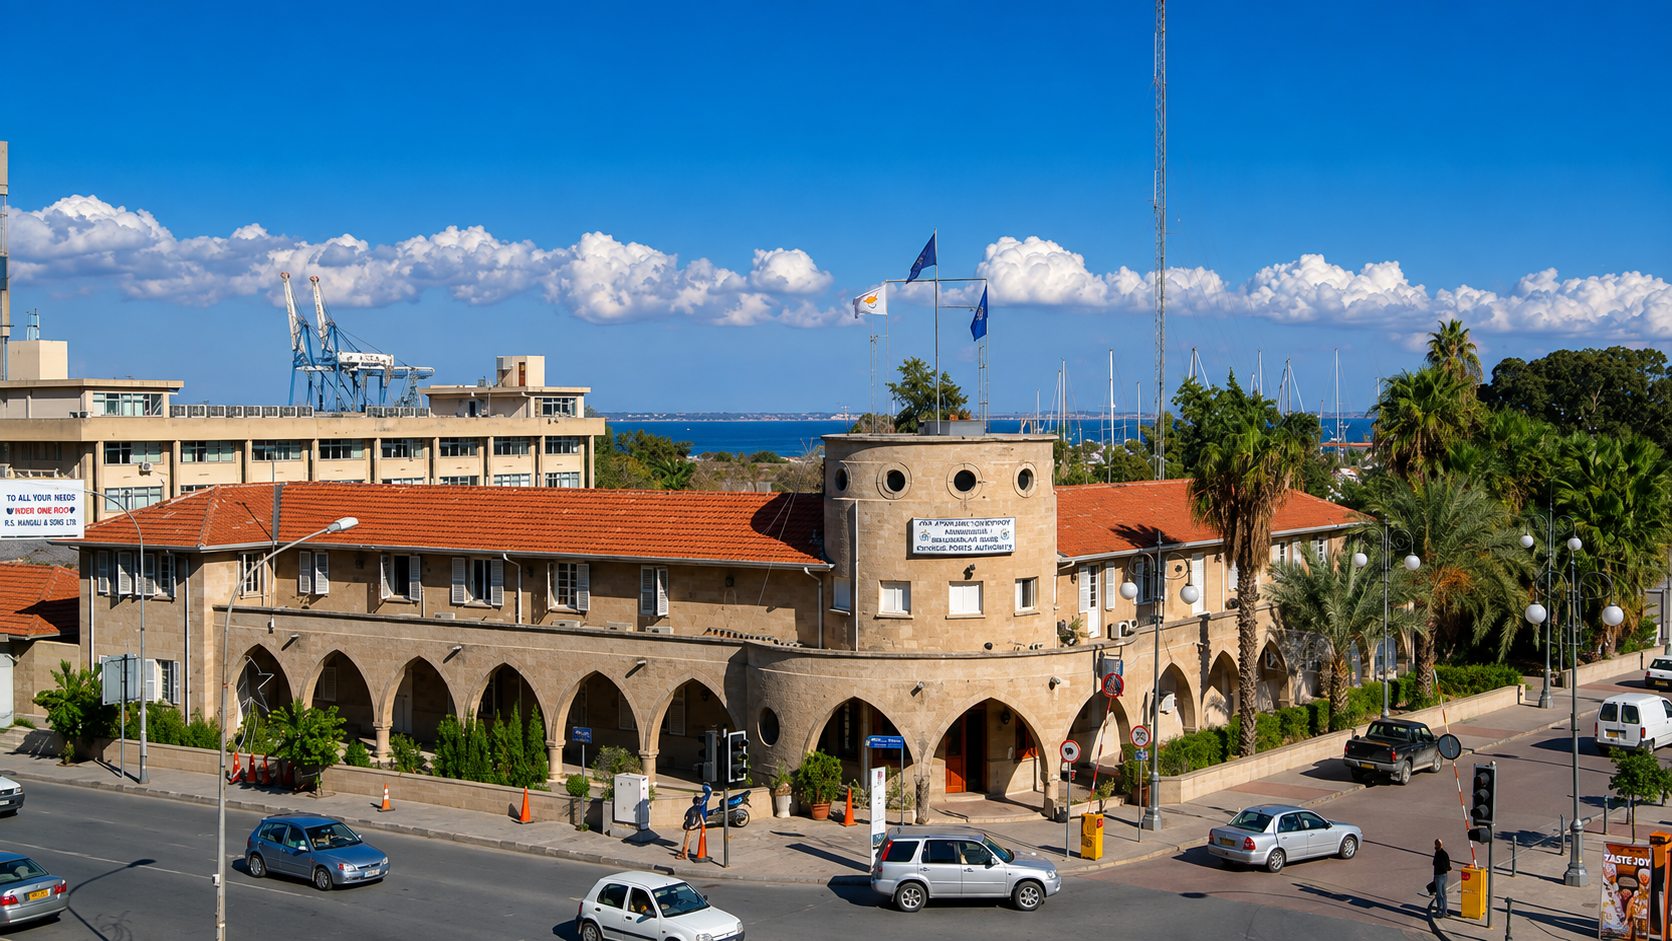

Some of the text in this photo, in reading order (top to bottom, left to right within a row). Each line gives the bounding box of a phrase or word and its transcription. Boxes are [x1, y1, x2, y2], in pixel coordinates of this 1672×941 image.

[6, 494, 17, 502] TO
[18, 494, 31, 502] ALL
[32, 494, 52, 502] YOUR
[1604, 854, 1650, 866] TASTE JOY
